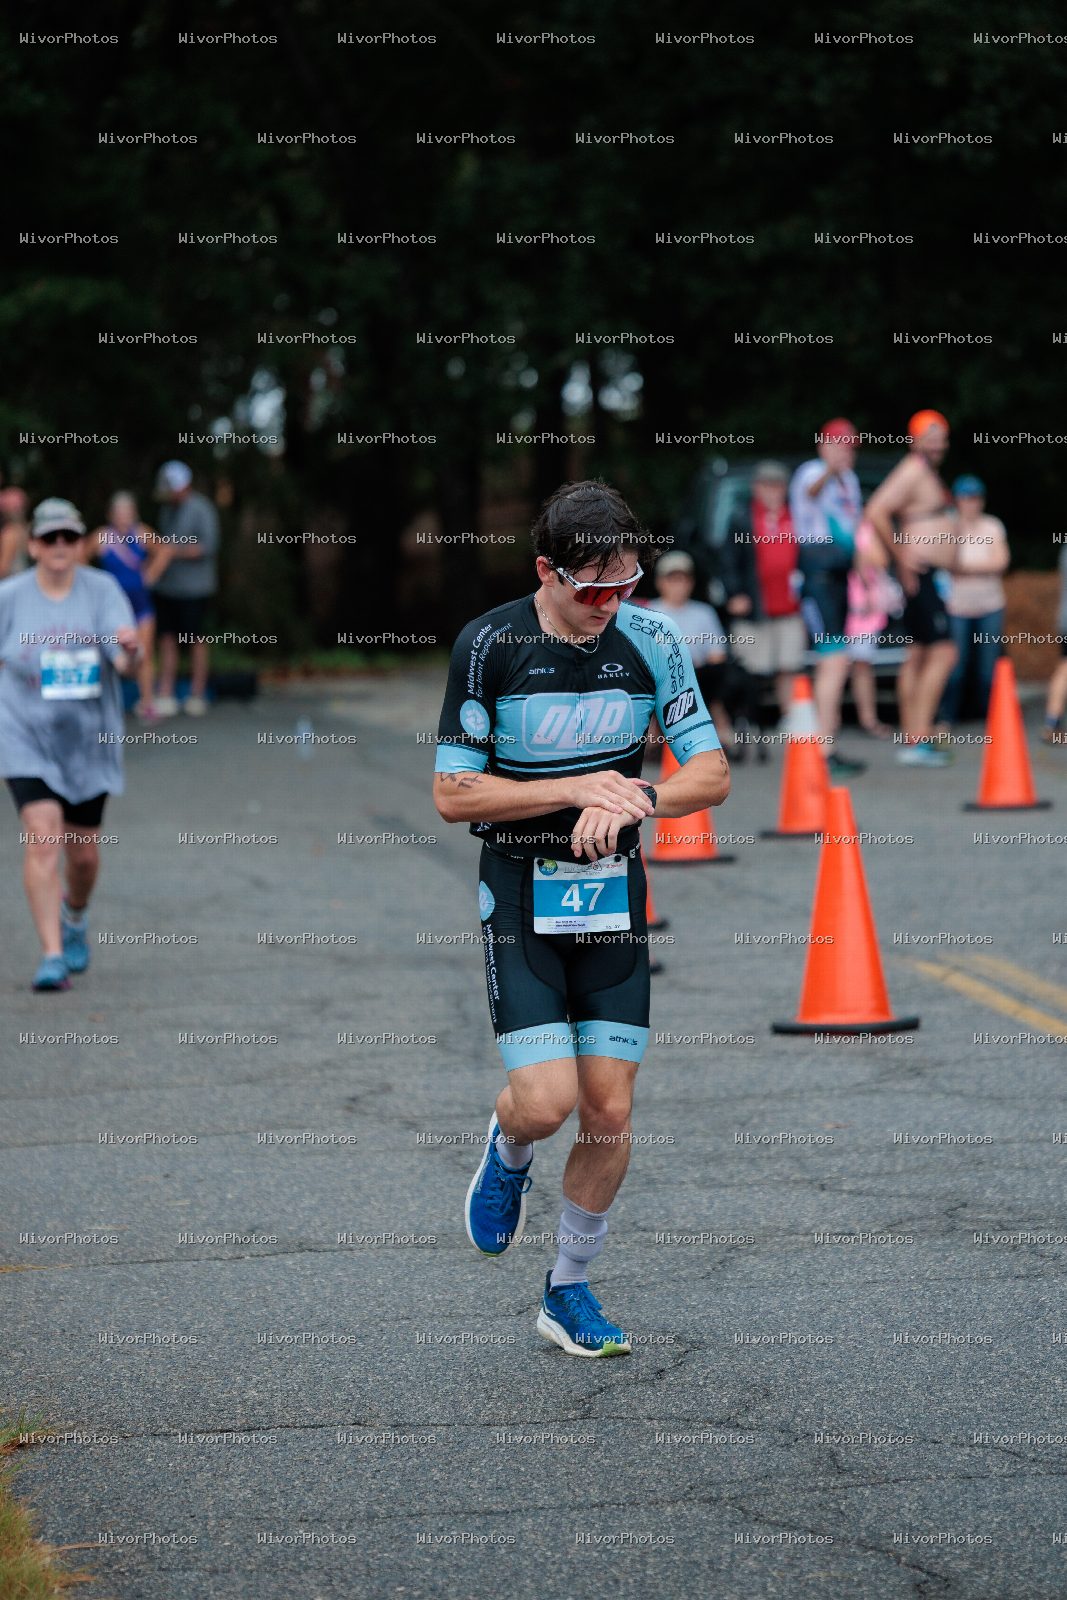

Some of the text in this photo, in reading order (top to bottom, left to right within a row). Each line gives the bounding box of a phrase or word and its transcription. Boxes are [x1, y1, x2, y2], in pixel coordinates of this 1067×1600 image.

[467, 623, 492, 694] Midwest Center
[561, 882, 605, 912] 47
[490, 967, 500, 1001] Center
